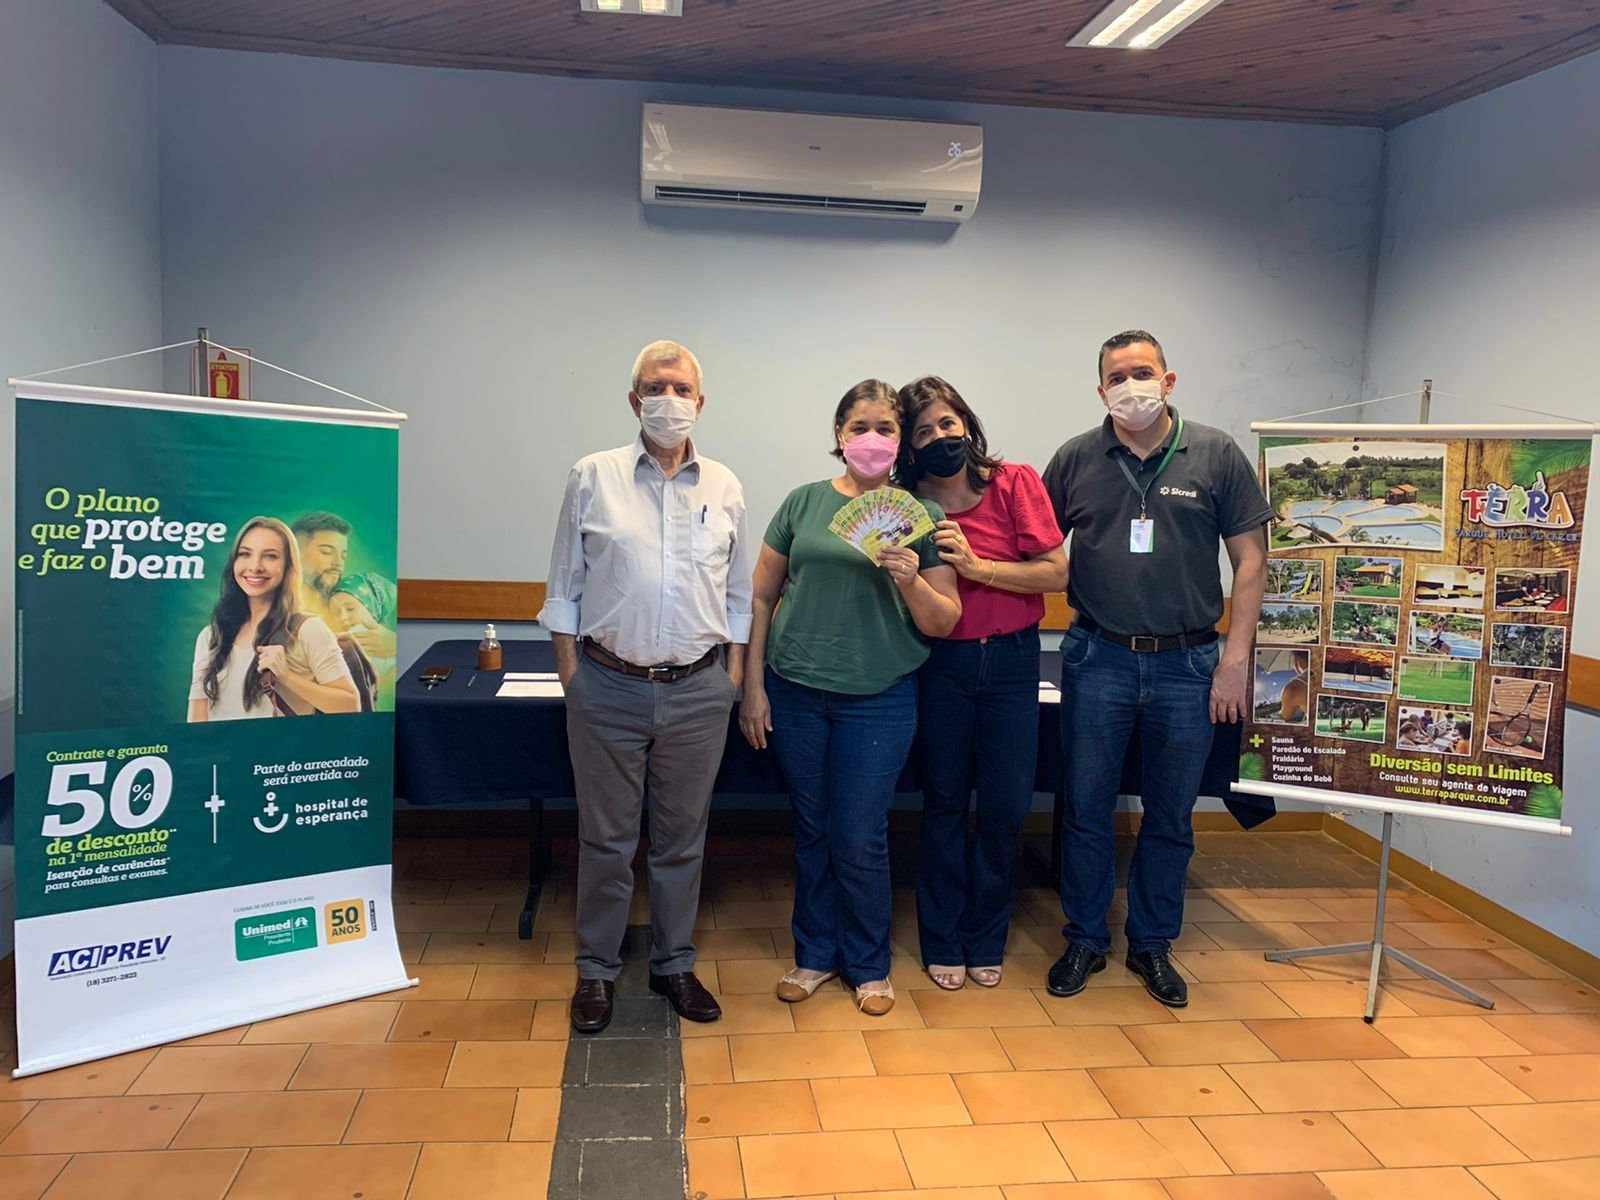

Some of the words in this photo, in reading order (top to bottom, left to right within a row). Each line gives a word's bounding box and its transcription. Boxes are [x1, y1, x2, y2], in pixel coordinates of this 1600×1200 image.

[217, 351, 227, 361] A
[1170, 487, 1198, 498] Sicredi
[45, 487, 70, 510] O
[74, 488, 160, 518] plano
[1460, 489, 1575, 526] TERRA
[31, 523, 81, 545] que
[81, 516, 227, 552] protege
[18, 554, 35, 570] e
[36, 548, 85, 576] faz
[90, 555, 107, 570] o
[109, 543, 205, 580] bem
[1271, 736, 1294, 744] Sauna
[46, 749, 104, 762] Contrate
[106, 748, 115, 758] e
[116, 744, 168, 760] garanta
[1302, 746, 1312, 754] de
[253, 764, 285, 775] Parte
[287, 761, 302, 772] do
[304, 756, 369, 770] arrecadado
[1272, 764, 1313, 772] Playground
[1370, 753, 1442, 773] Diversão
[1447, 763, 1482, 777] sem
[1488, 764, 1554, 784] Limites
[263, 774, 288, 787] será
[290, 769, 342, 784] revertida
[344, 770, 360, 778] ao
[1303, 774, 1312, 782] do
[1379, 771, 1418, 785] Consulte
[1422, 778, 1438, 787] seu
[1442, 779, 1473, 791] agente
[1477, 784, 1488, 793] de
[1492, 786, 1527, 798] viagem
[1394, 785, 1510, 806] www.terraparque.com.br
[296, 798, 348, 814] hospital
[352, 797, 368, 807] de
[296, 809, 368, 826] esperança
[46, 838, 73, 856] de
[48, 856, 66, 867] na
[84, 844, 168, 862] mensalidade
[44, 882, 70, 894] para
[71, 874, 120, 888] consultas
[128, 868, 168, 880] exames.
[46, 866, 93, 881] Isenção
[95, 864, 110, 874] de
[332, 906, 359, 927] 50
[242, 920, 291, 936] Unimed
[332, 924, 361, 937] ANOS
[48, 935, 172, 976] ACIPREV
